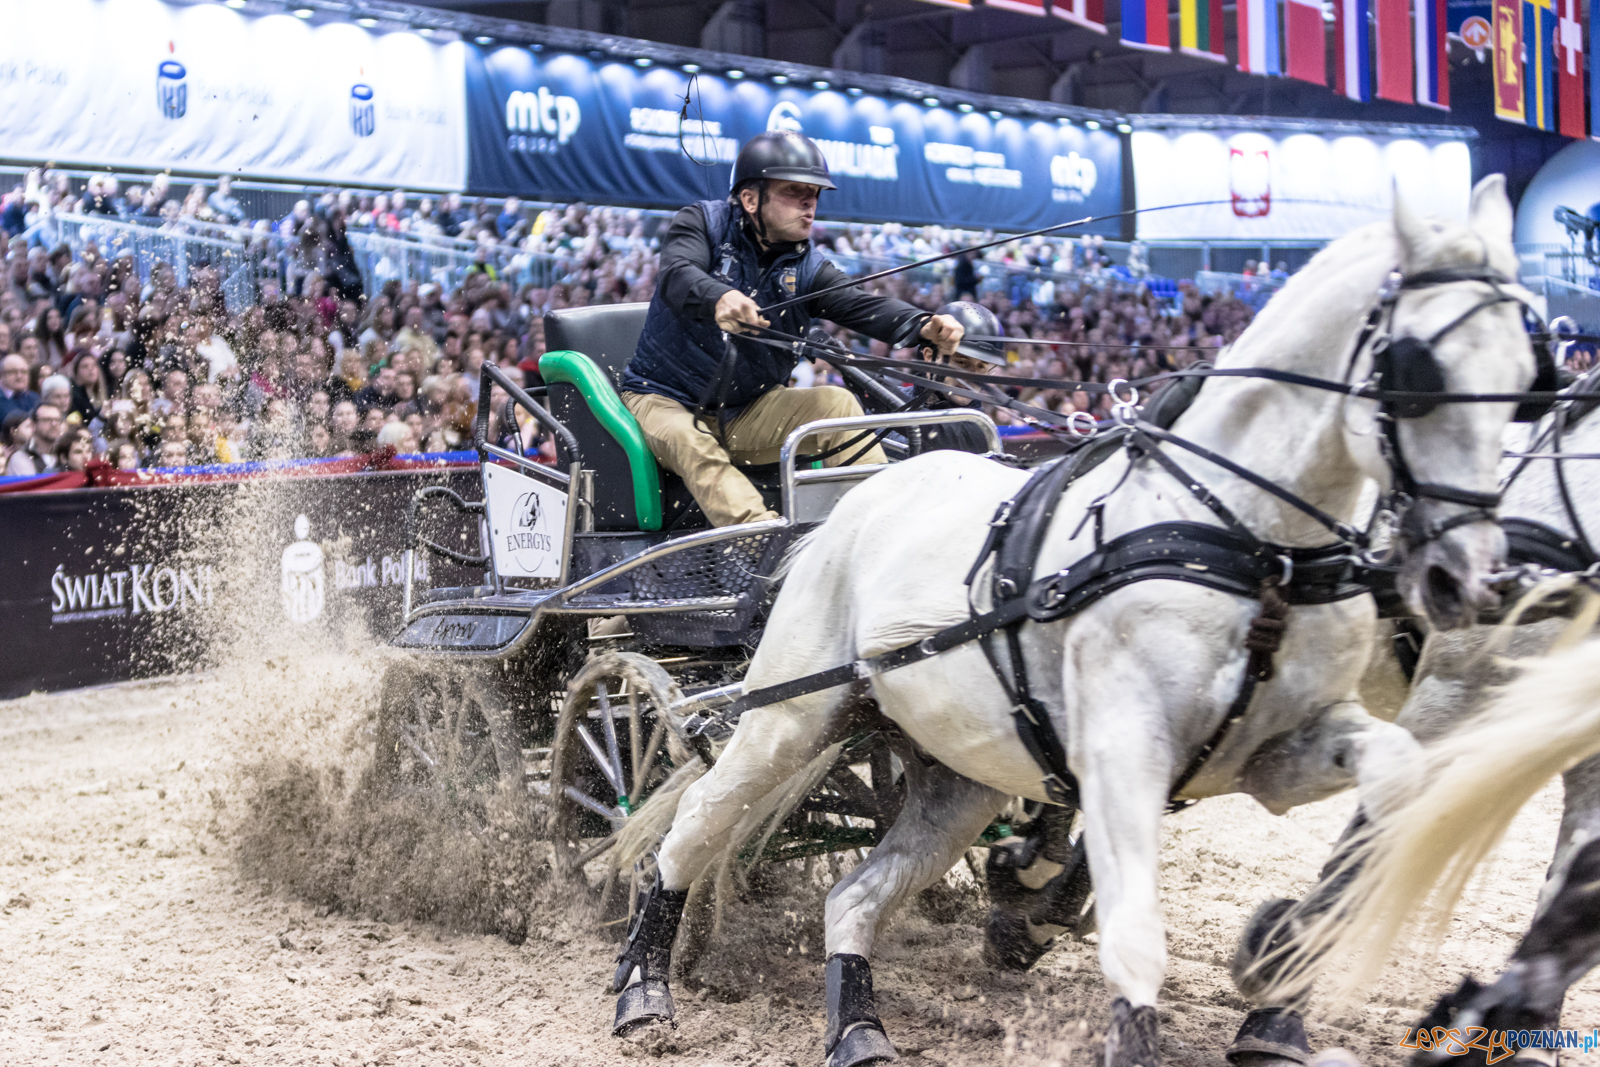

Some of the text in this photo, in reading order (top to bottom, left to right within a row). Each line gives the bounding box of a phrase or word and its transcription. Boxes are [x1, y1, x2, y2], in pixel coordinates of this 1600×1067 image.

[506, 86, 581, 145] mtp
[506, 532, 552, 552] ENERGYS
[51, 563, 212, 615] ŚWIAT KONI
[335, 552, 428, 590] Bank Polki
